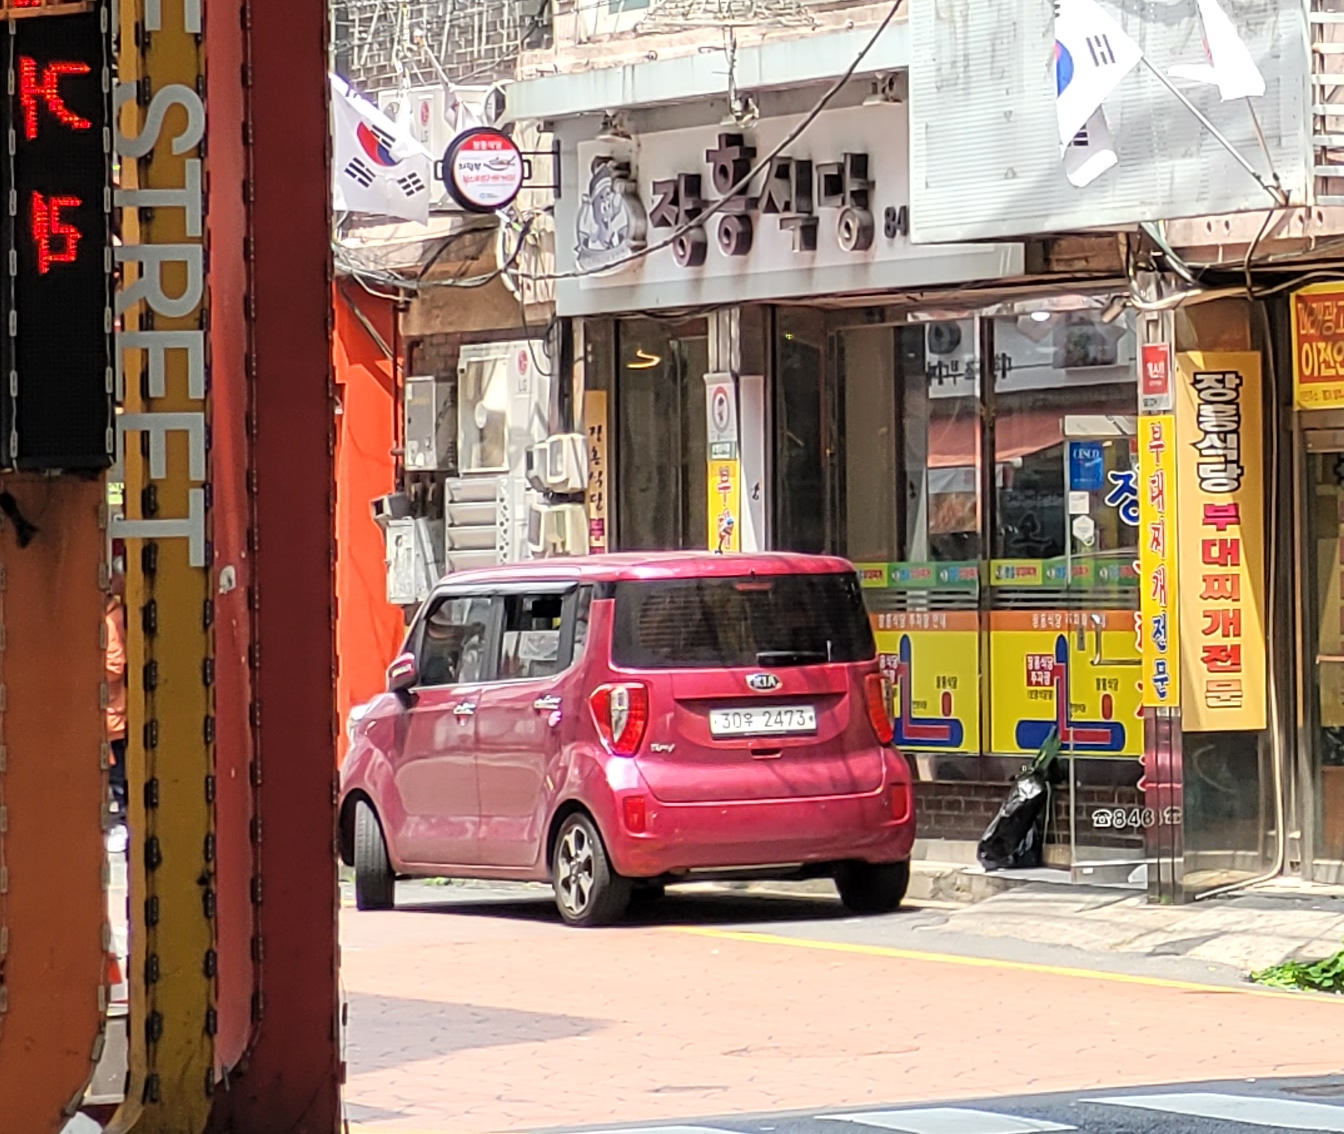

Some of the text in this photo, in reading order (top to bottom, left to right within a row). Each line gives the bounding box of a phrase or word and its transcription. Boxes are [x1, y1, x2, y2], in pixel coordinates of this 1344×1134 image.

[650, 132, 876, 267] 장흥식당
[109, 81, 206, 568] STREET
[1193, 371, 1245, 494] 장흥식당
[751, 674, 779, 686] KIA
[764, 709, 807, 728] 2473
